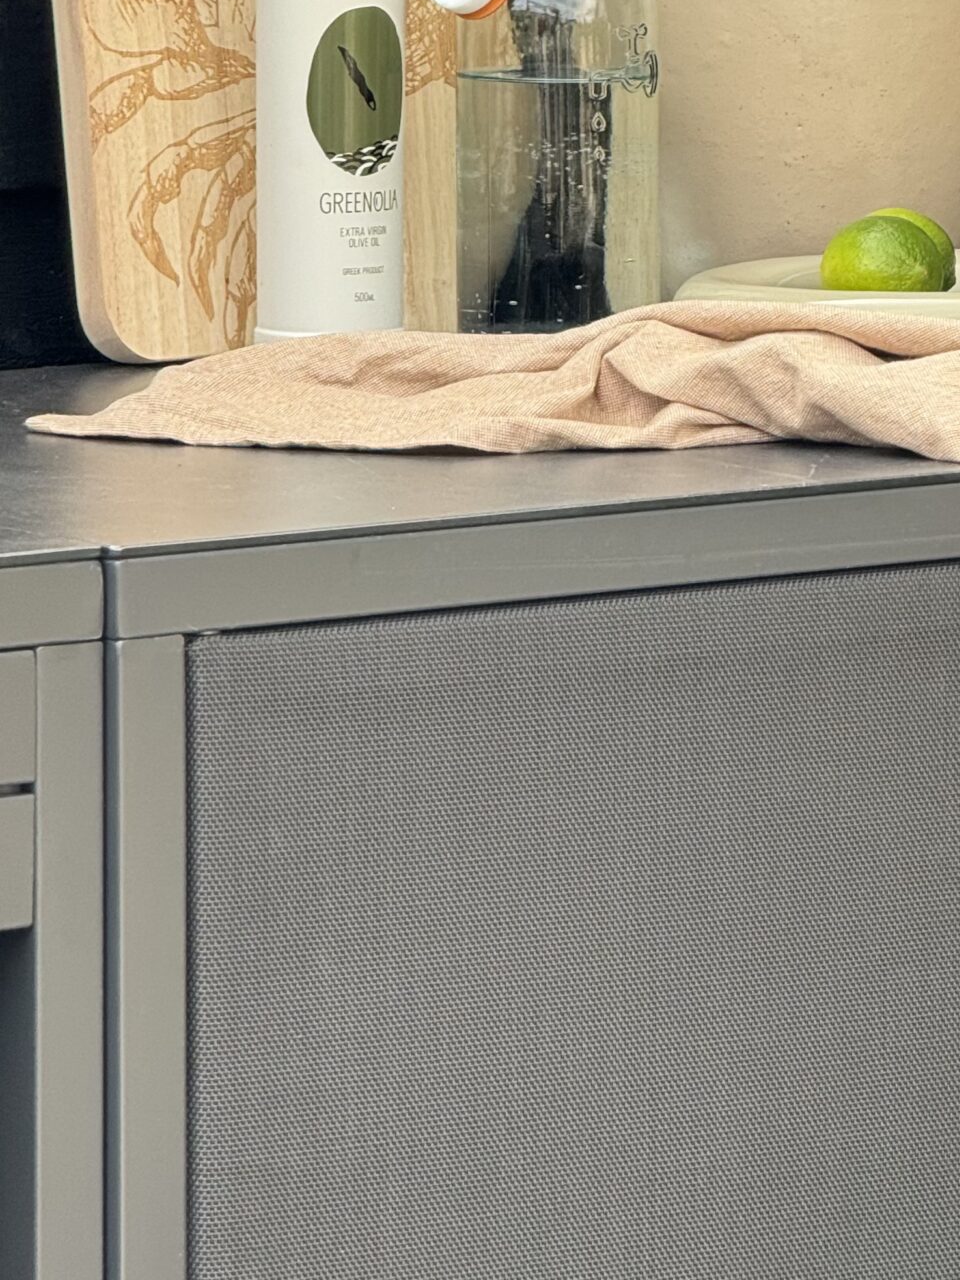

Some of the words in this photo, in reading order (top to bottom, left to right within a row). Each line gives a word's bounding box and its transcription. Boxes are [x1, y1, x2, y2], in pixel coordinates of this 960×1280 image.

[319, 188, 398, 214] GREENOLIA
[340, 227, 365, 238] EXTRA
[367, 225, 387, 236] VIRGIN
[348, 238, 369, 248] OLIVE
[371, 237, 380, 247] OIL
[342, 267, 361, 276] GREEK
[362, 265, 385, 274] PRODUCT
